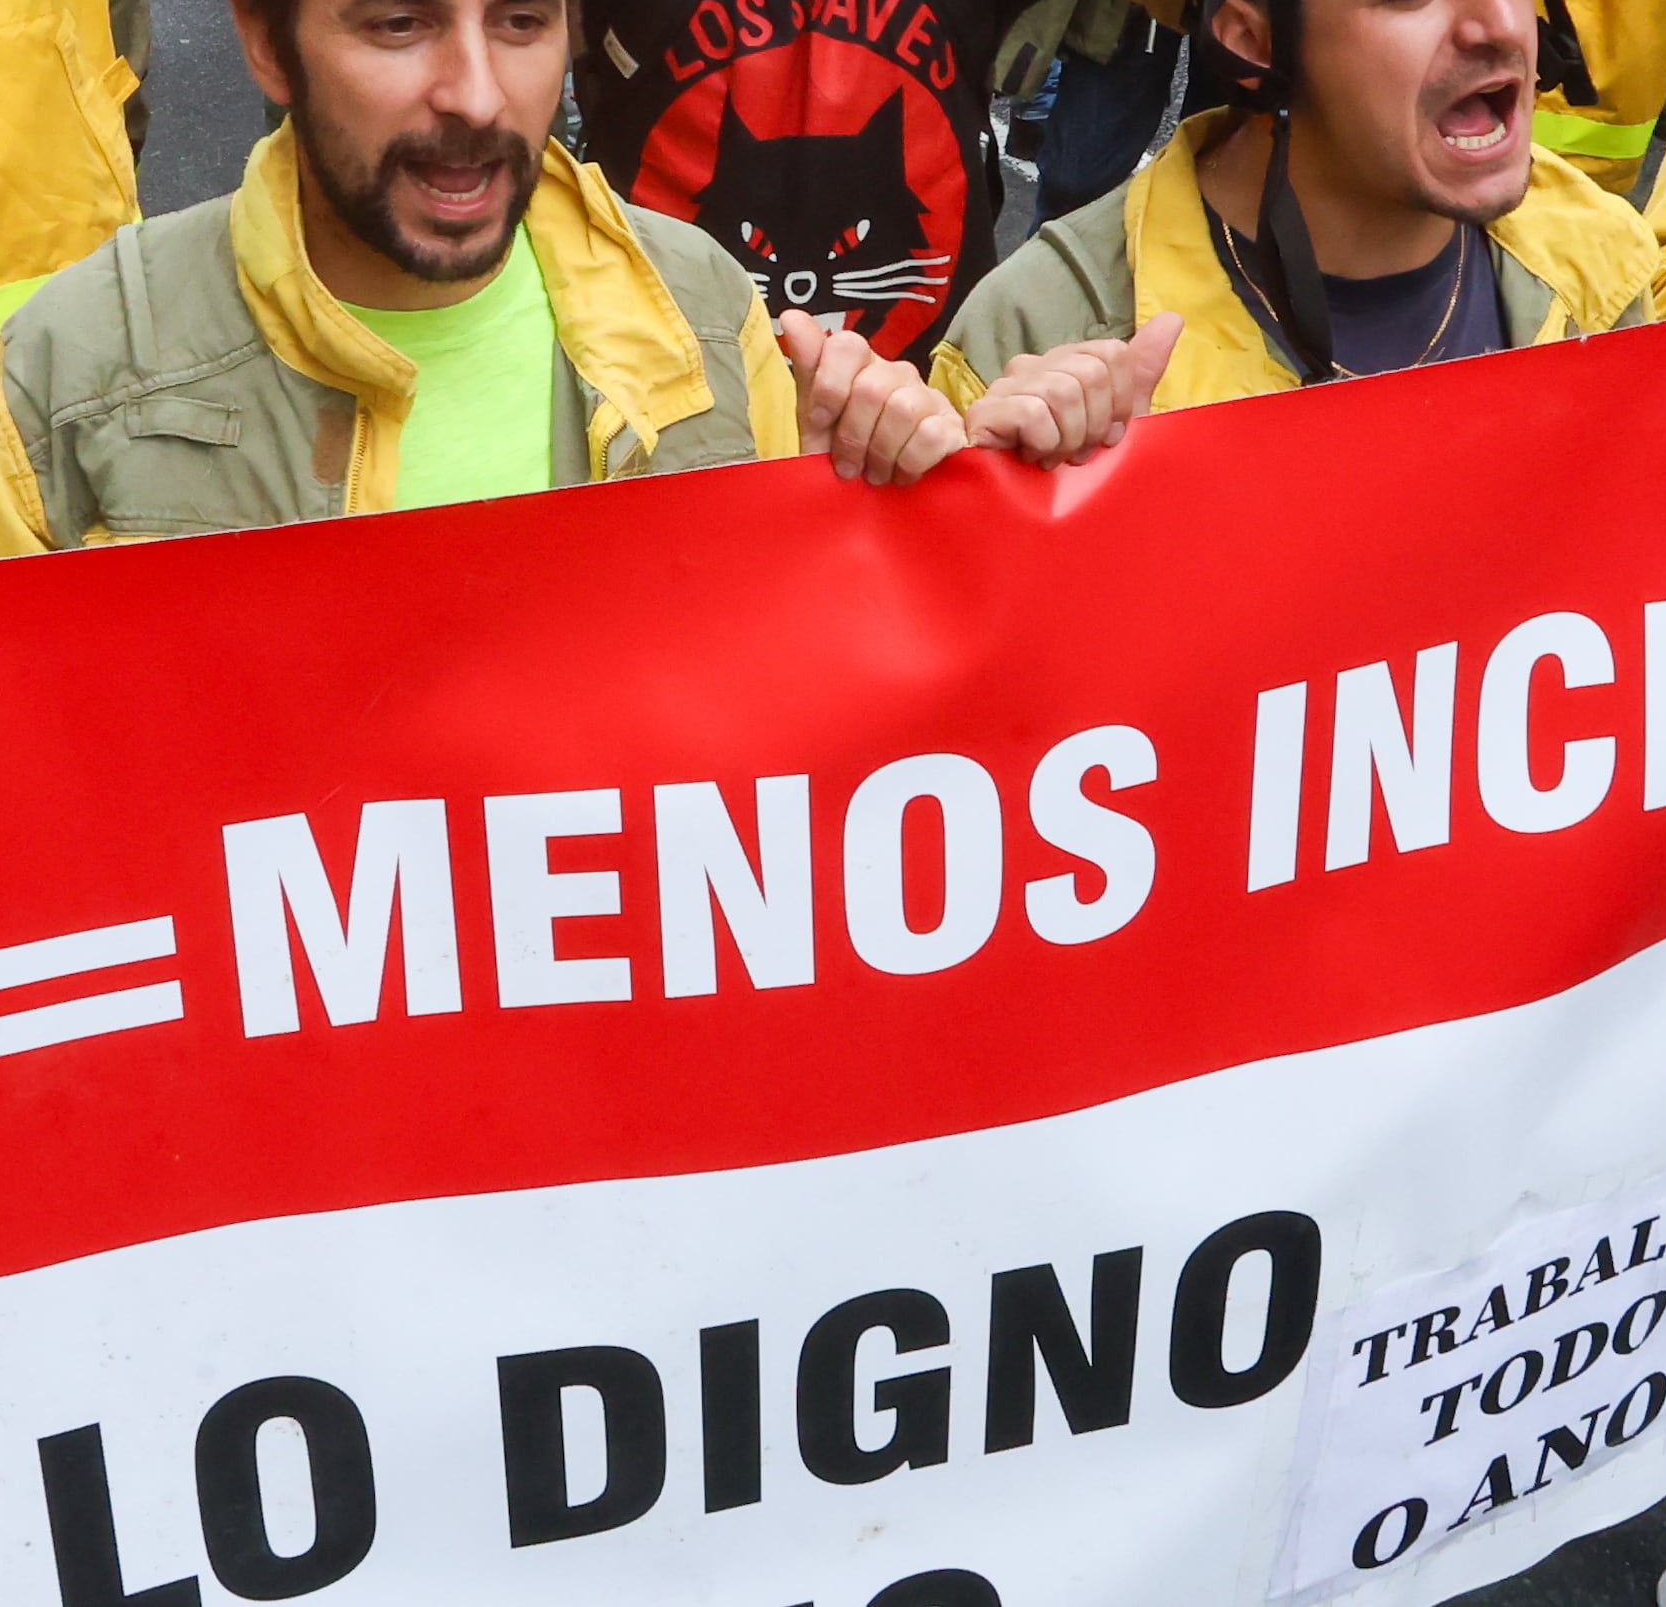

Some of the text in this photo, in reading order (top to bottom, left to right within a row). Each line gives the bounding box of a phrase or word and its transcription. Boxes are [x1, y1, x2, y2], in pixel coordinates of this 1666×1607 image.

[223, 722, 1156, 1038] MENOS
[496, 1208, 1324, 1550] DIGNO
[1351, 1496, 1429, 1570] O
